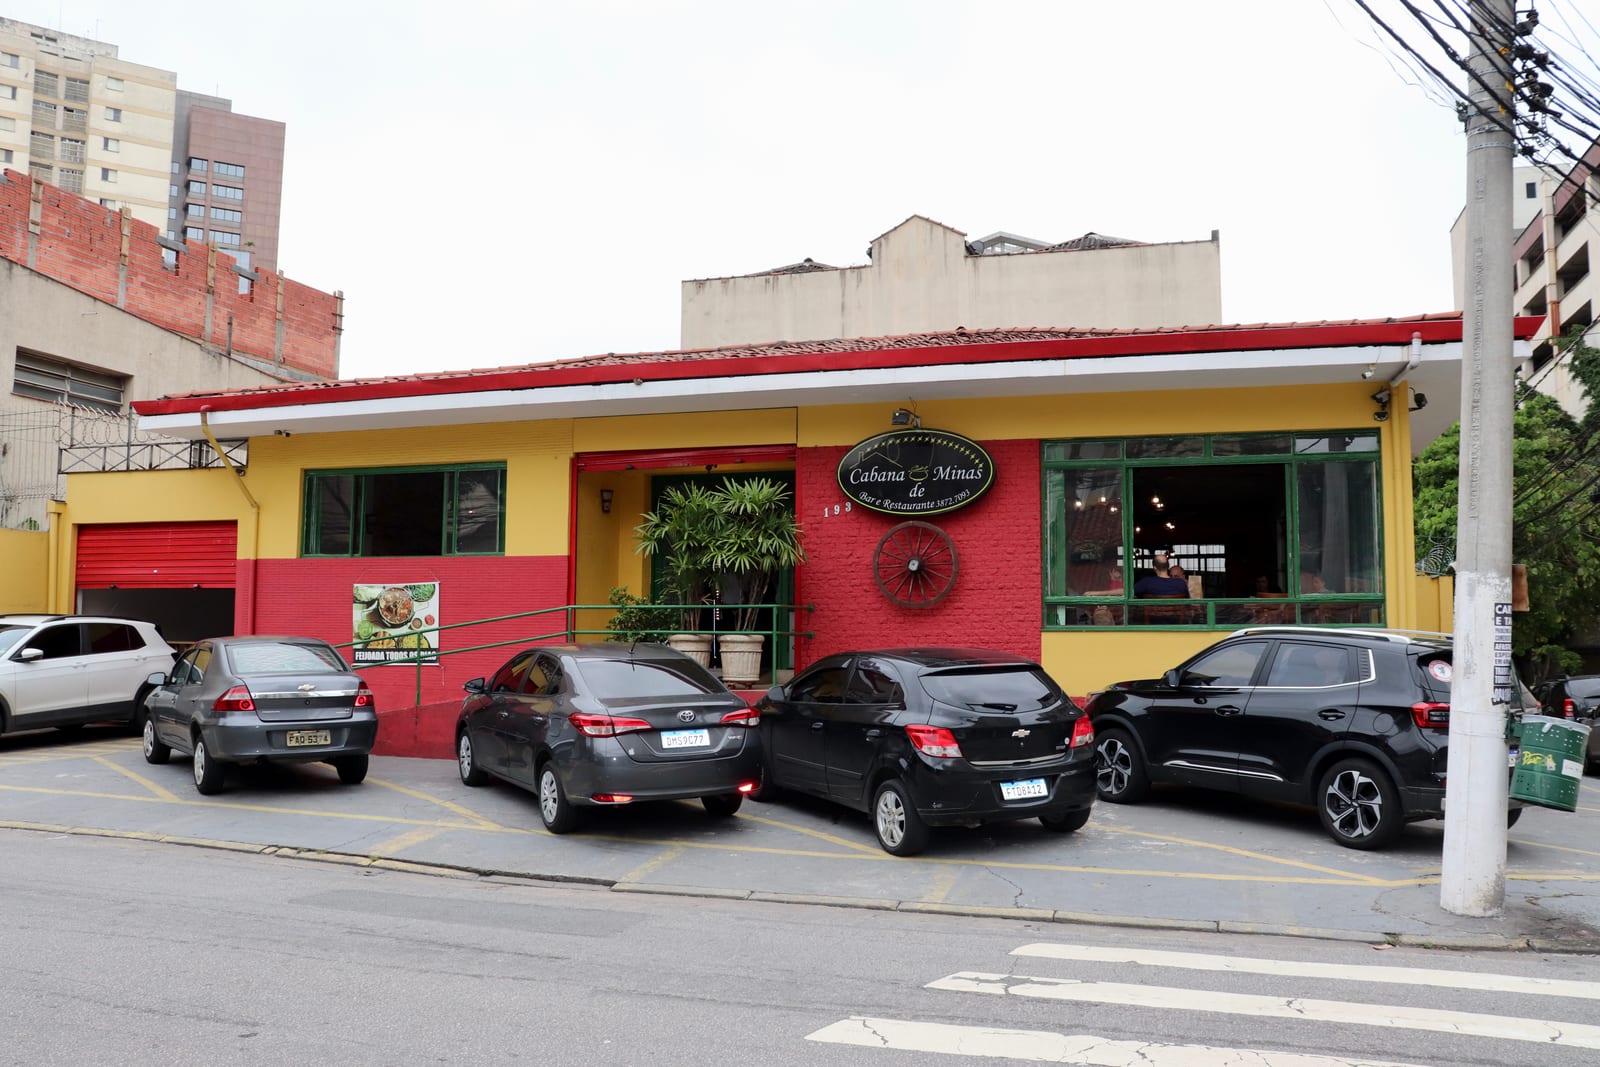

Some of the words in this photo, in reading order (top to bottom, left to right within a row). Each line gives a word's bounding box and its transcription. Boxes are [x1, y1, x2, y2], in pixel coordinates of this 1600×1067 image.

[850, 466, 905, 484] Cabana
[933, 465, 983, 480] Minas
[909, 482, 925, 498] de
[859, 491, 875, 504] Bar
[883, 499, 935, 510] Restaurante
[936, 489, 971, 508] 3872.7093
[824, 501, 851, 518] 193
[355, 651, 385, 660] FEIJOADA
[386, 651, 408, 661] TODOS
